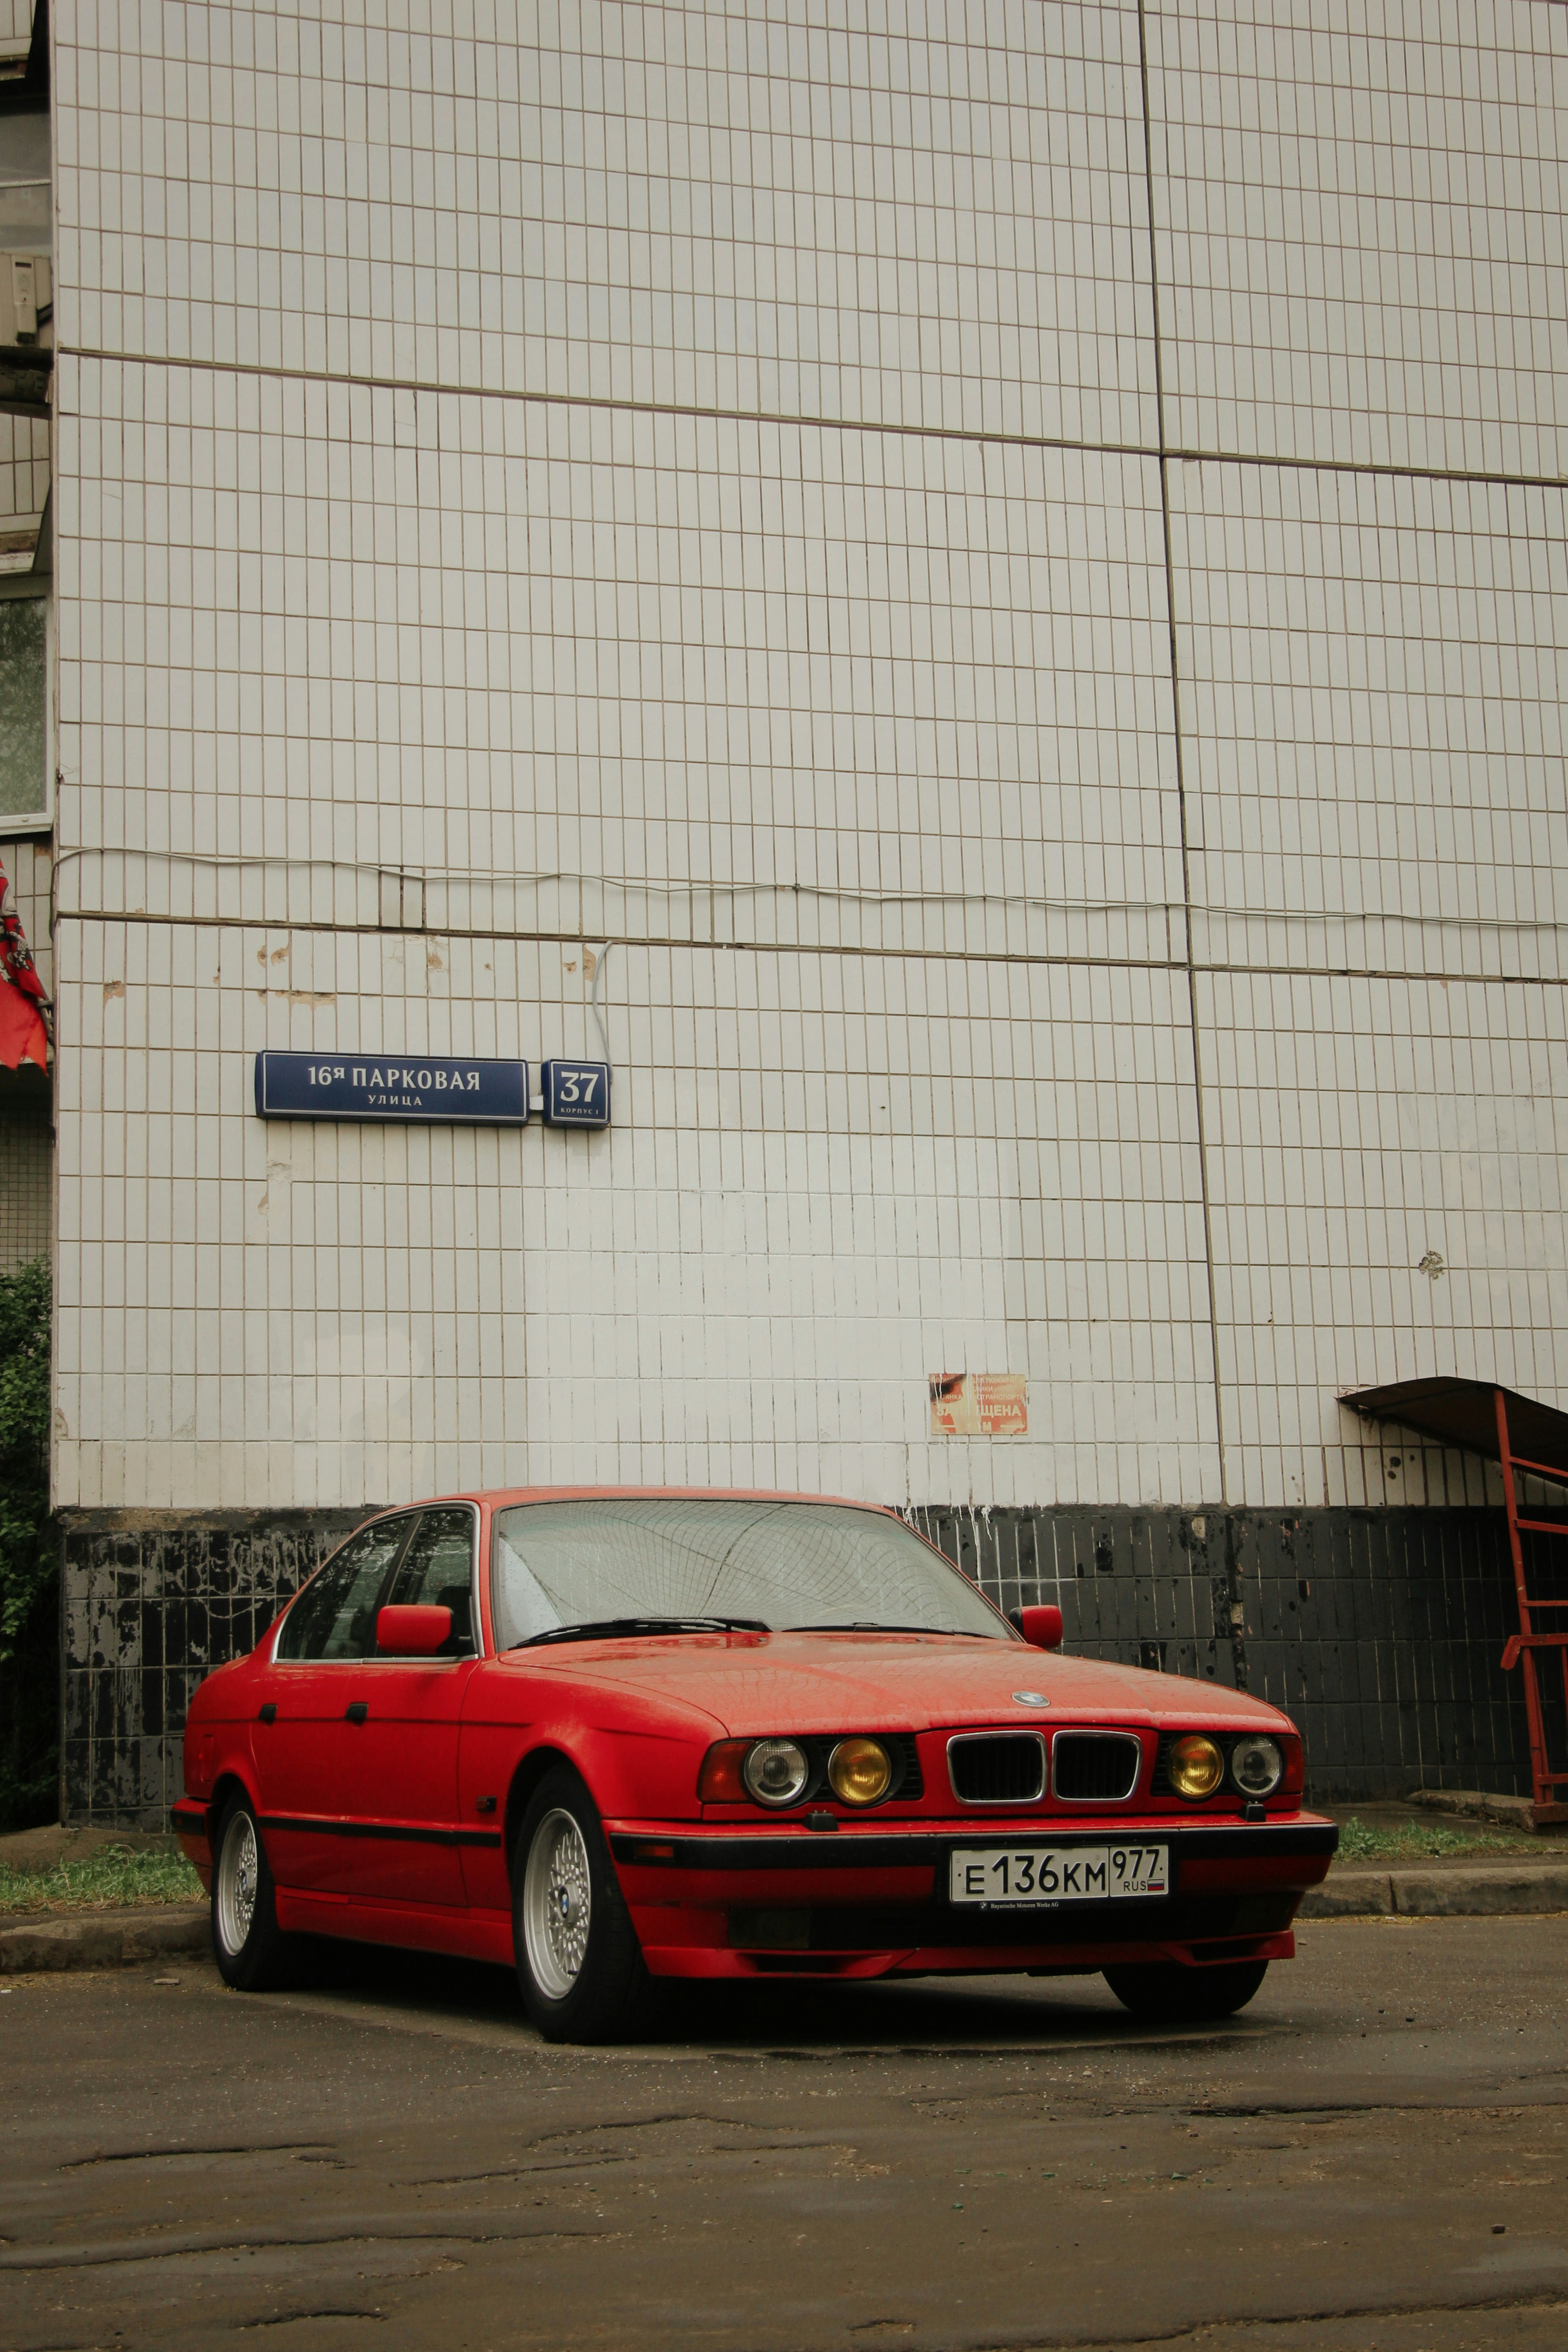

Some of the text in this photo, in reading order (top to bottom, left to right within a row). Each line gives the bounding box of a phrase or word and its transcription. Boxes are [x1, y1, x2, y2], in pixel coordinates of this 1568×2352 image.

[353, 1068, 480, 1090] ПАРКОВАЯ
[560, 1071, 599, 1102] 37
[368, 1095, 422, 1107] УЛИЦА
[1112, 1849, 1160, 1879] 977
[1123, 1881, 1146, 1891] RUS
